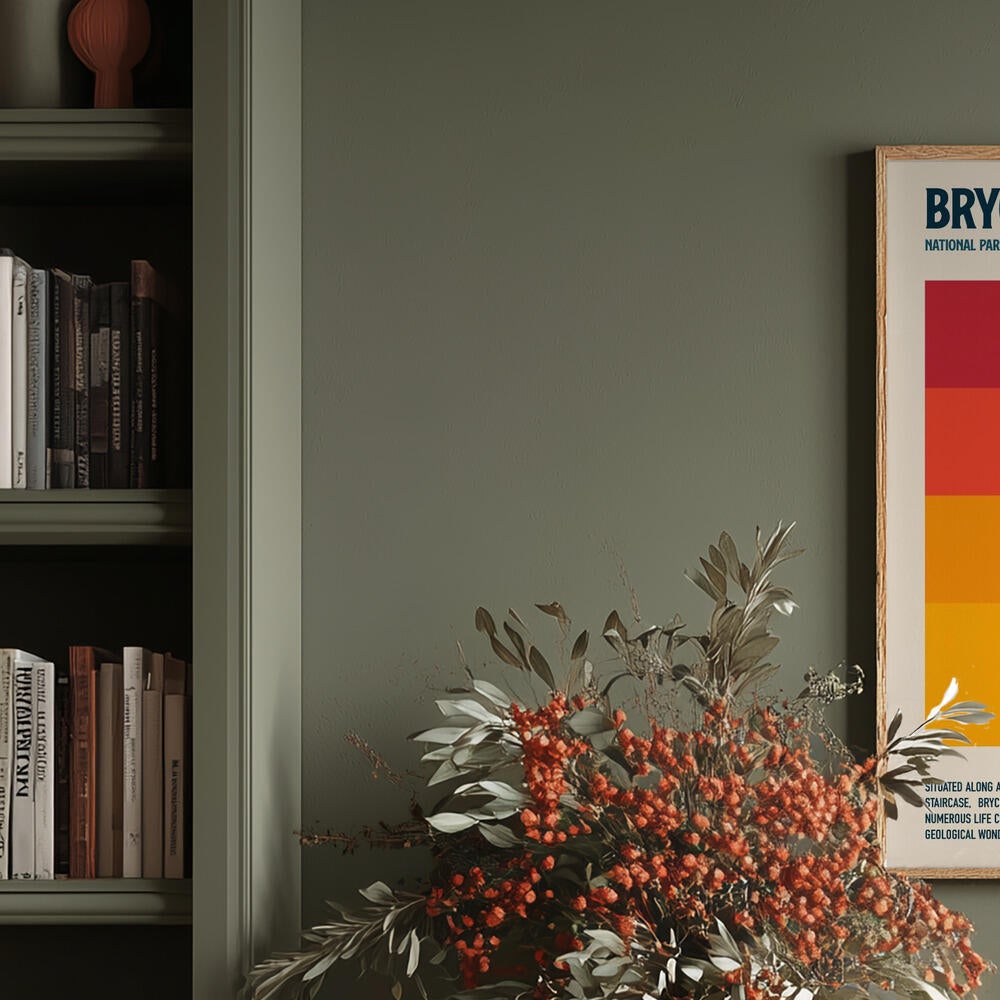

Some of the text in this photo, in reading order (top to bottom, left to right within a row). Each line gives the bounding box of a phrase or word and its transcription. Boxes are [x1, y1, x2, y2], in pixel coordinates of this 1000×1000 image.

[924, 238, 977, 252] NATIONAL
[924, 781, 963, 793] SITUATED
[965, 781, 994, 793] ALONG
[924, 797, 972, 810] STAIRCASE,
[924, 811, 972, 824] NUMEROUS
[973, 812, 992, 825] LIFE
[924, 828, 977, 840] GEOLOGICAL
